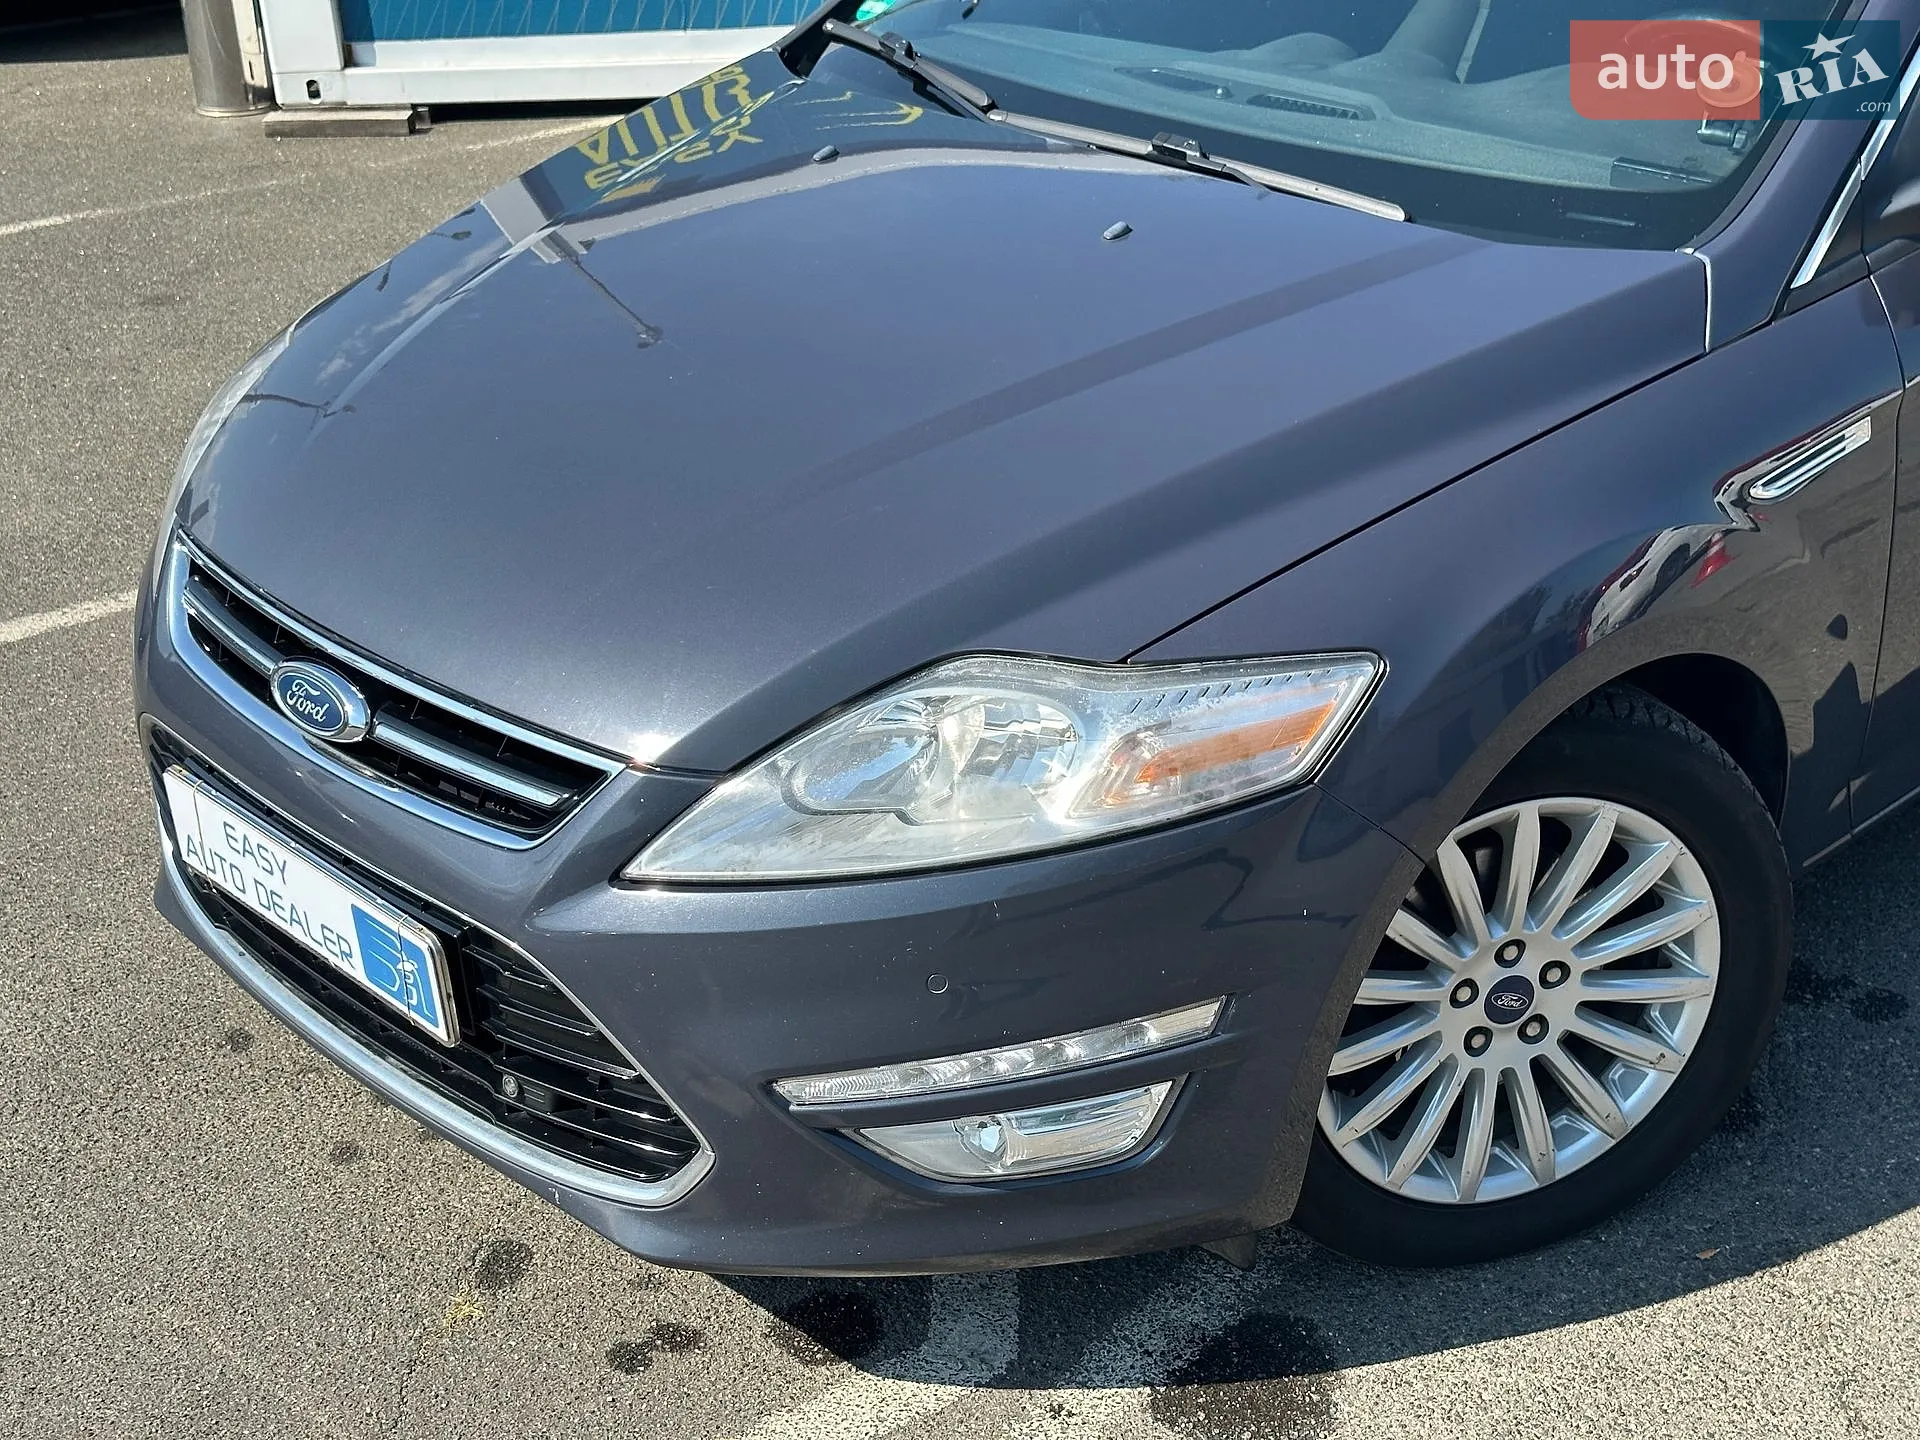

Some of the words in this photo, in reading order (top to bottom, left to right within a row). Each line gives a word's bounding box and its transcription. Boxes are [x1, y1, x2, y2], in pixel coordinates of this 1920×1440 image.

[286, 679, 330, 722] Ford
[222, 820, 288, 886] EASY
[186, 834, 246, 895] AUTO
[253, 877, 356, 969] DEALER
[1497, 994, 1523, 1008] Ford
